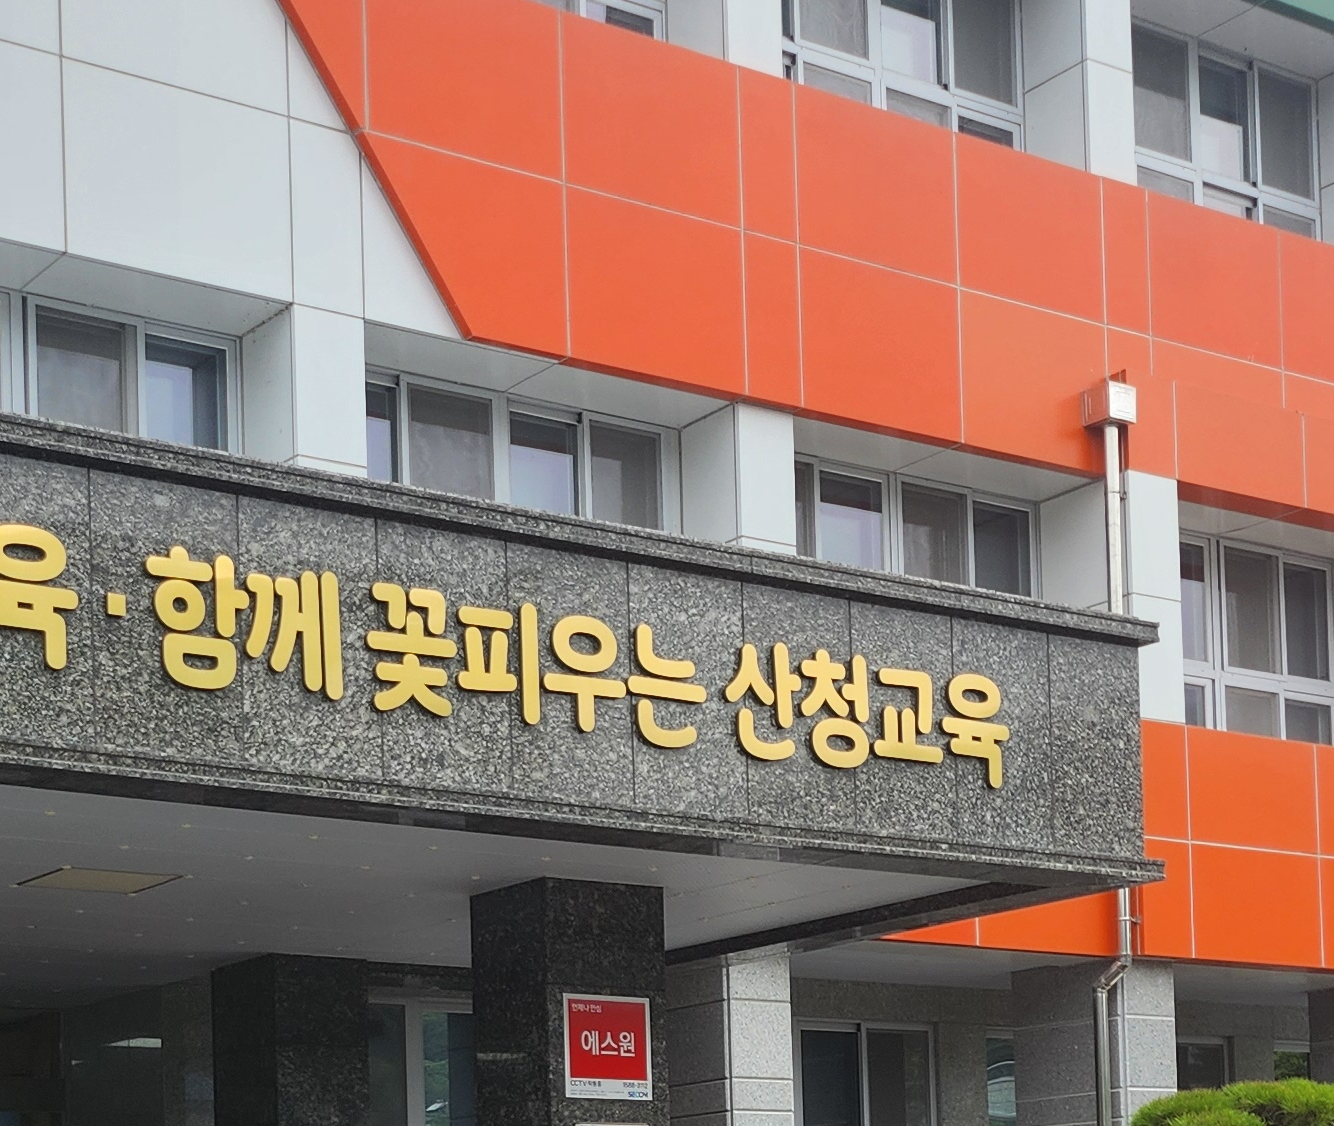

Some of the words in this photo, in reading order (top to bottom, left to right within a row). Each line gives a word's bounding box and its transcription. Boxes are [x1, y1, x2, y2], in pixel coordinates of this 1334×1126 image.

[145, 547, 343, 700] 함께
[366, 582, 707, 749] 꽃피우는
[723, 642, 1010, 788] 산청교육
[581, 1030, 636, 1057] 에스원
